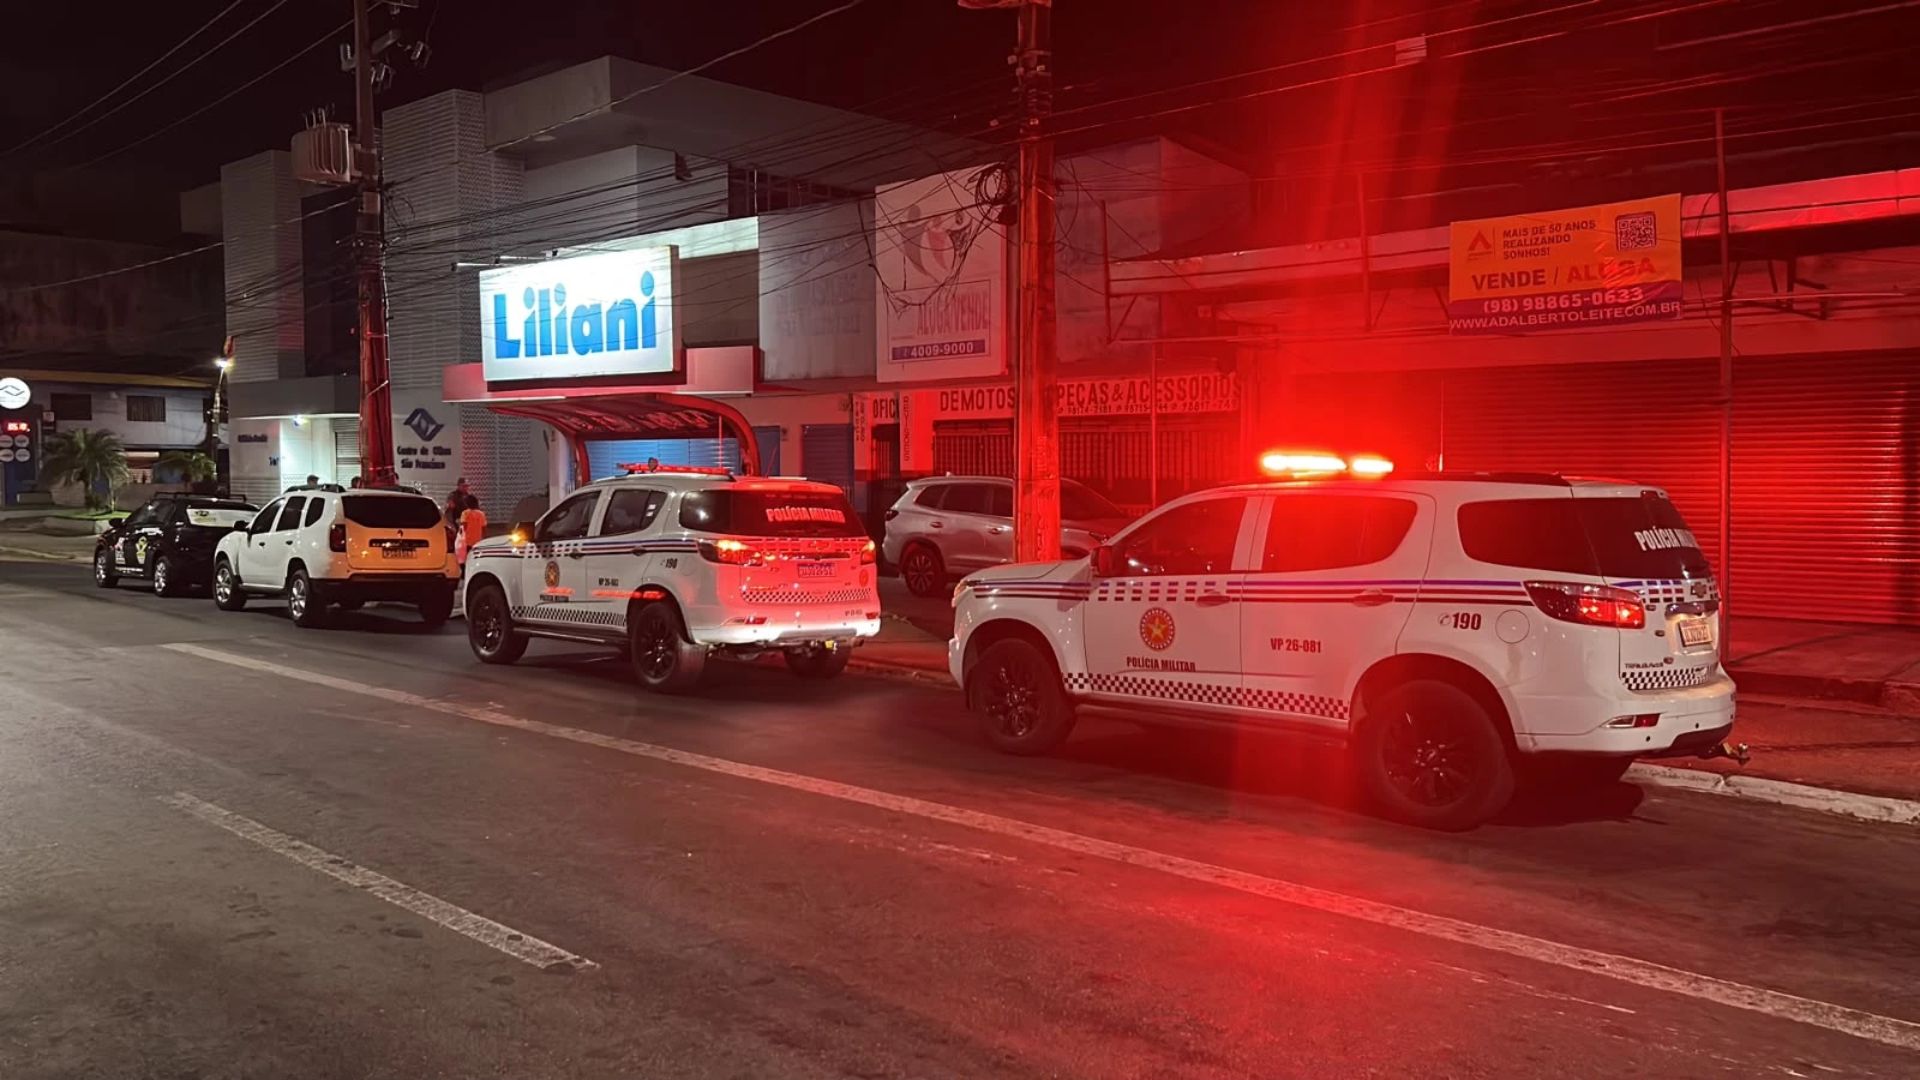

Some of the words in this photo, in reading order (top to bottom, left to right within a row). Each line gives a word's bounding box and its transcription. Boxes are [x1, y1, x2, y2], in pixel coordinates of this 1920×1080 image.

[1503, 228, 1528, 238] MAIS
[1531, 226, 1546, 236] DE
[1549, 224, 1561, 233] 50
[1565, 220, 1596, 231] ANOS
[1503, 234, 1571, 249] REALIZANDO
[1503, 248, 1550, 260] SONHOS!
[1472, 267, 1546, 291] VENDE
[1483, 298, 1518, 314] (98)
[1522, 287, 1644, 311] 98865-0633
[493, 270, 657, 359] Liliani
[910, 342, 974, 358] 4009-9000
[766, 505, 810, 522] POLÍCIA
[1633, 526, 1681, 552] POLÍCIA
[1451, 612, 1482, 631] 190
[1270, 638, 1284, 651] VP
[1286, 638, 1322, 654] 26-081
[1126, 656, 1160, 670] POLÍCIA
[1161, 659, 1196, 672] MILITAR
